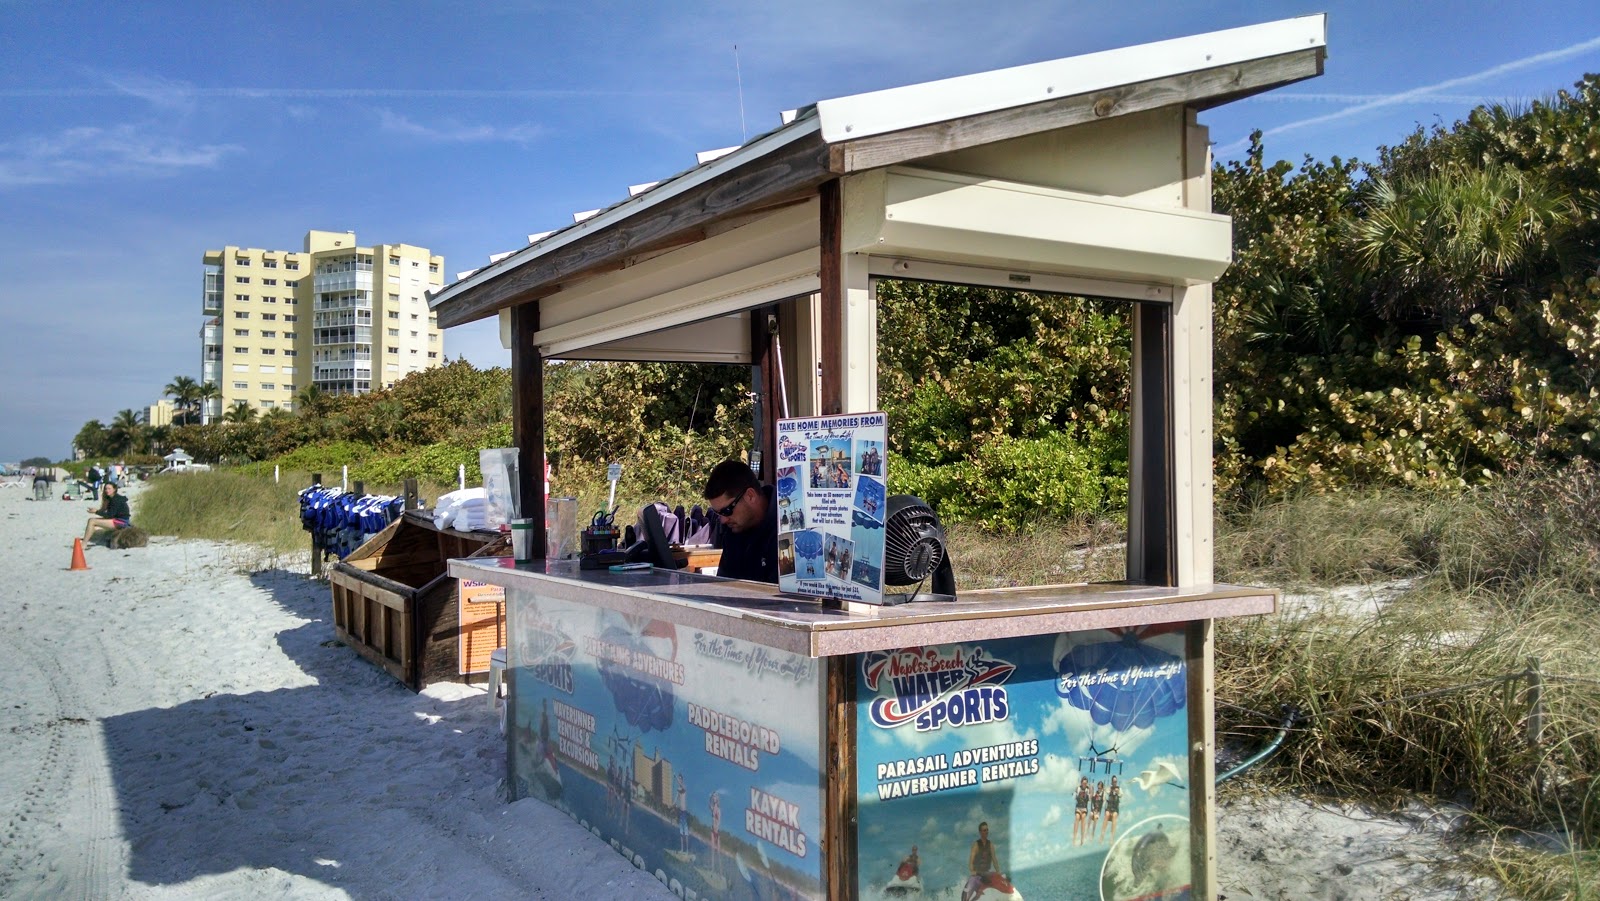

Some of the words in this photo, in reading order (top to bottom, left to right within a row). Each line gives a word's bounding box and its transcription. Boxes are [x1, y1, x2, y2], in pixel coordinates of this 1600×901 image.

[779, 422, 795, 431] TAKE
[797, 420, 818, 430] HOME
[821, 417, 858, 429] MEMORIES
[860, 415, 883, 426] FROM
[812, 431, 823, 439] Time
[788, 452, 806, 462] SPORTS
[535, 655, 573, 694] SPORTS
[631, 651, 685, 687] ADVENTURES
[694, 632, 707, 653] For
[723, 639, 742, 660] Time
[745, 645, 755, 670] of
[755, 646, 778, 674] Your
[780, 654, 812, 681] Life!
[887, 654, 928, 680] Naples
[926, 650, 964, 673] Beach
[1060, 671, 1077, 689] For
[1096, 667, 1119, 685] Time
[1120, 666, 1131, 686] of
[1130, 664, 1154, 686] Your
[1154, 661, 1182, 680] Life!
[893, 669, 965, 714] WATER
[916, 687, 1008, 730] SPORTS
[553, 699, 596, 733] WAVERUNNER
[558, 719, 583, 745] RENTALS
[584, 730, 592, 749] &
[688, 702, 780, 756] PADDLEBOARD
[560, 736, 599, 771] EXCURSIONS
[705, 731, 759, 772] RENTALS
[876, 753, 949, 782] PARASAIL
[952, 739, 1039, 769] ADVENTURES
[877, 768, 979, 801] WAVERUNNER
[981, 758, 1040, 784] RENTALS
[751, 787, 800, 831] KAYAK
[746, 809, 806, 859] RENTALS
